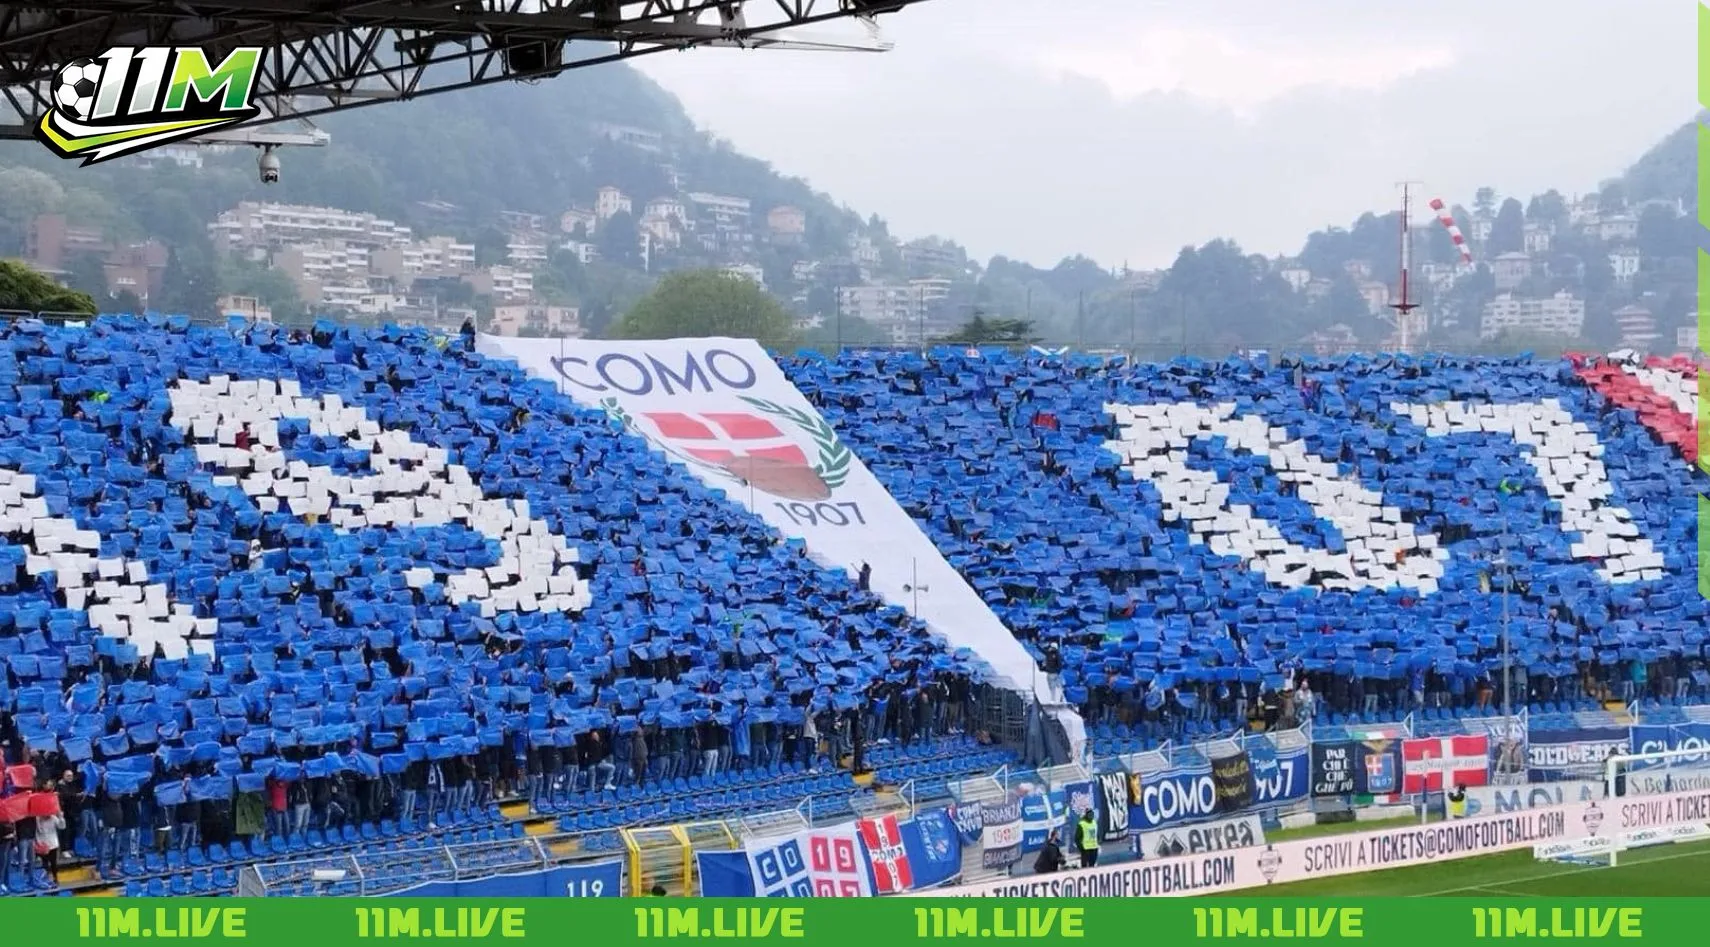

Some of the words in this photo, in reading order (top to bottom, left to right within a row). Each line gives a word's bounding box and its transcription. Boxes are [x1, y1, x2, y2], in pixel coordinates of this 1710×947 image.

[550, 349, 757, 396] COMO
[774, 501, 867, 527] 1907
[1143, 776, 1216, 825] COMO
[1621, 801, 1662, 828] SCRIVI
[1665, 799, 1674, 823] A
[1304, 841, 1352, 872] SCRIVI
[1357, 840, 1368, 866] A
[1369, 811, 1565, 864] TICKETS@COMOFOOTBALL.COM
